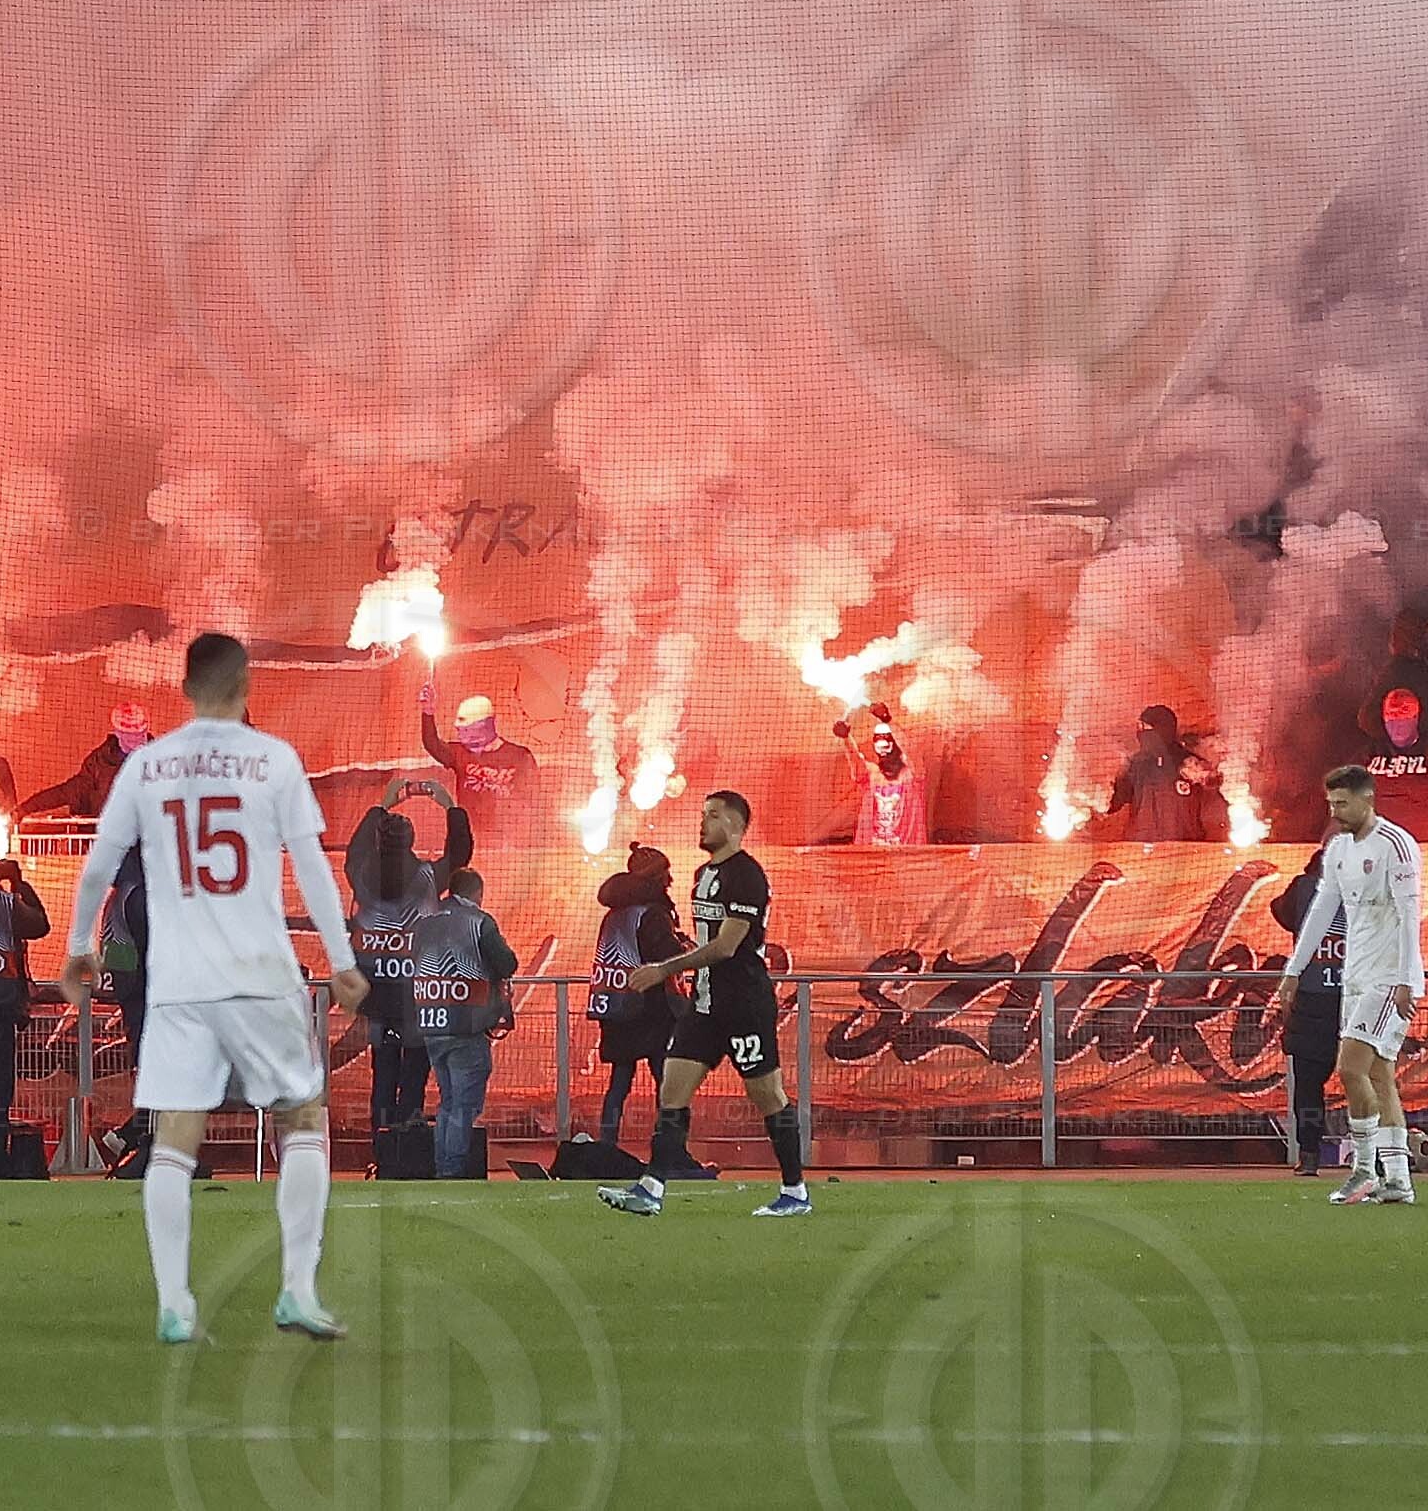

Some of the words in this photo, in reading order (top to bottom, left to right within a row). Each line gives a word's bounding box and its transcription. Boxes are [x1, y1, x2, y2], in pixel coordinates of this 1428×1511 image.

[162, 795, 250, 897] 15
[374, 957, 416, 978] 100
[413, 979, 469, 1001] PHOTO
[419, 1007, 449, 1028] 118
[730, 1034, 764, 1064] 22
